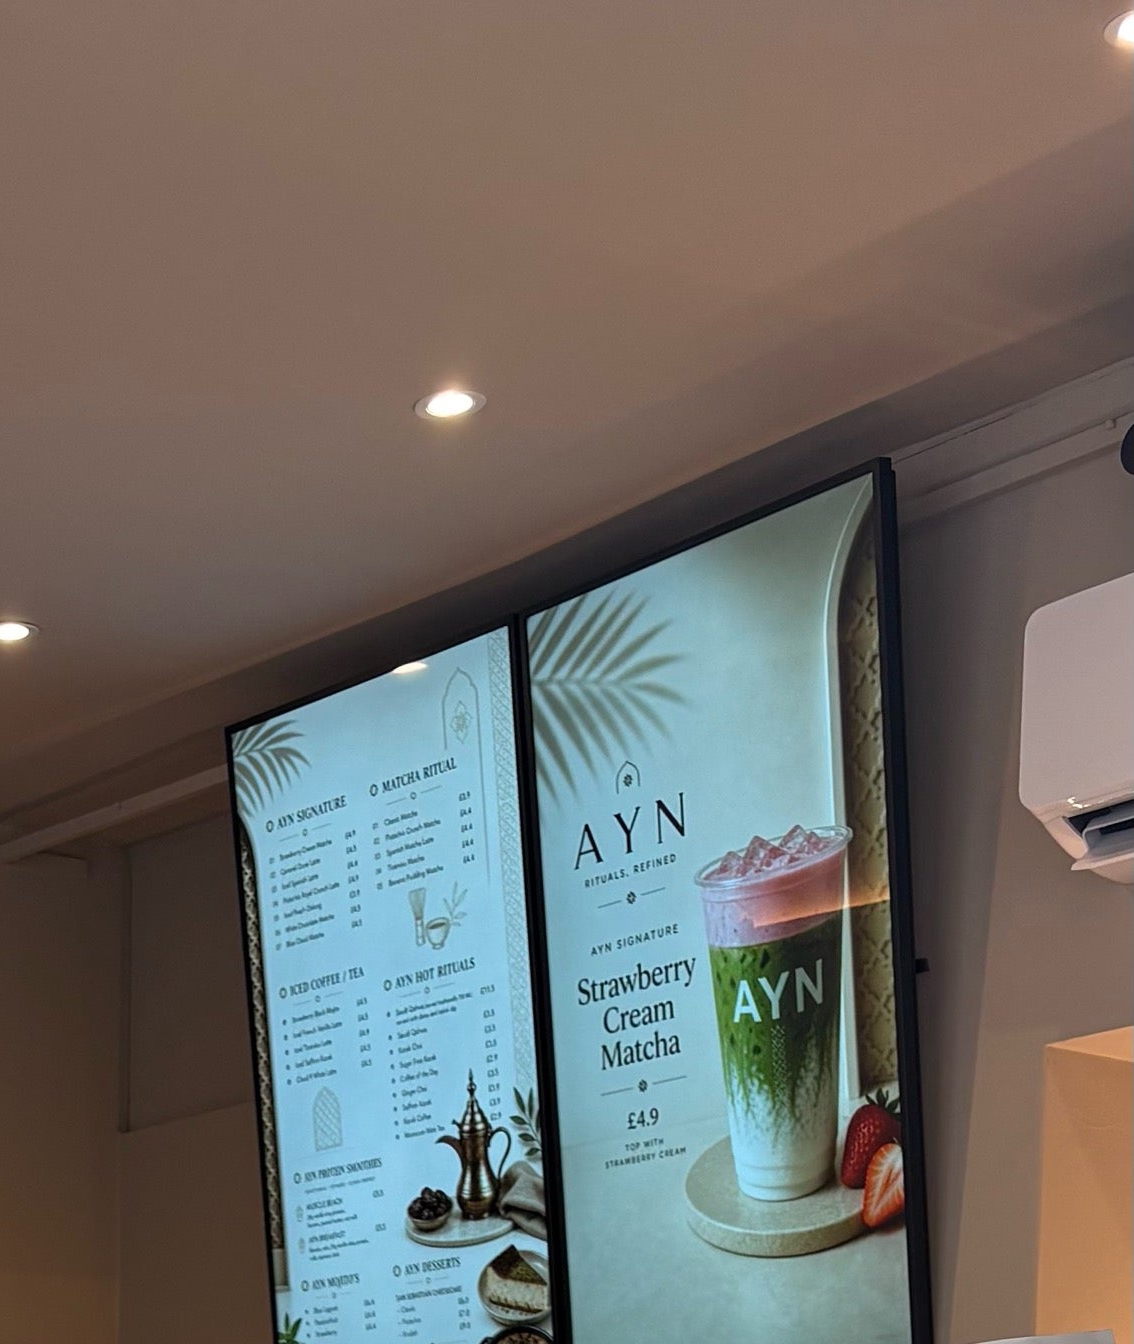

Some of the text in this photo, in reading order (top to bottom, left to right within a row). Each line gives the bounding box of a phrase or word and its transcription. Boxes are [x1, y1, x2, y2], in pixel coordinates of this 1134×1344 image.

[382, 758, 457, 793] MATCHA RITUAL
[276, 796, 348, 830] AYN SIGNATURE
[574, 792, 685, 870] AYN
[584, 854, 676, 888] RITUALS, REFINED
[591, 923, 679, 956] AYN SIGNATURE
[290, 982, 309, 996] ICED
[311, 973, 340, 990] COFFEE
[348, 967, 364, 980] TEA
[395, 957, 476, 989] AYN HOT RITUALS
[578, 958, 696, 1006] Strawberry
[733, 959, 824, 1023] AYN
[603, 999, 675, 1034] Cream
[601, 1031, 681, 1070] Matcha
[627, 1107, 659, 1130] £4.9
[605, 1146, 687, 1169] STRAWBERRY CREAM
[625, 1138, 664, 1151] TOP WITH
[404, 1257, 461, 1276] AYN DESSERTS
[311, 1278, 325, 1290] AYN
